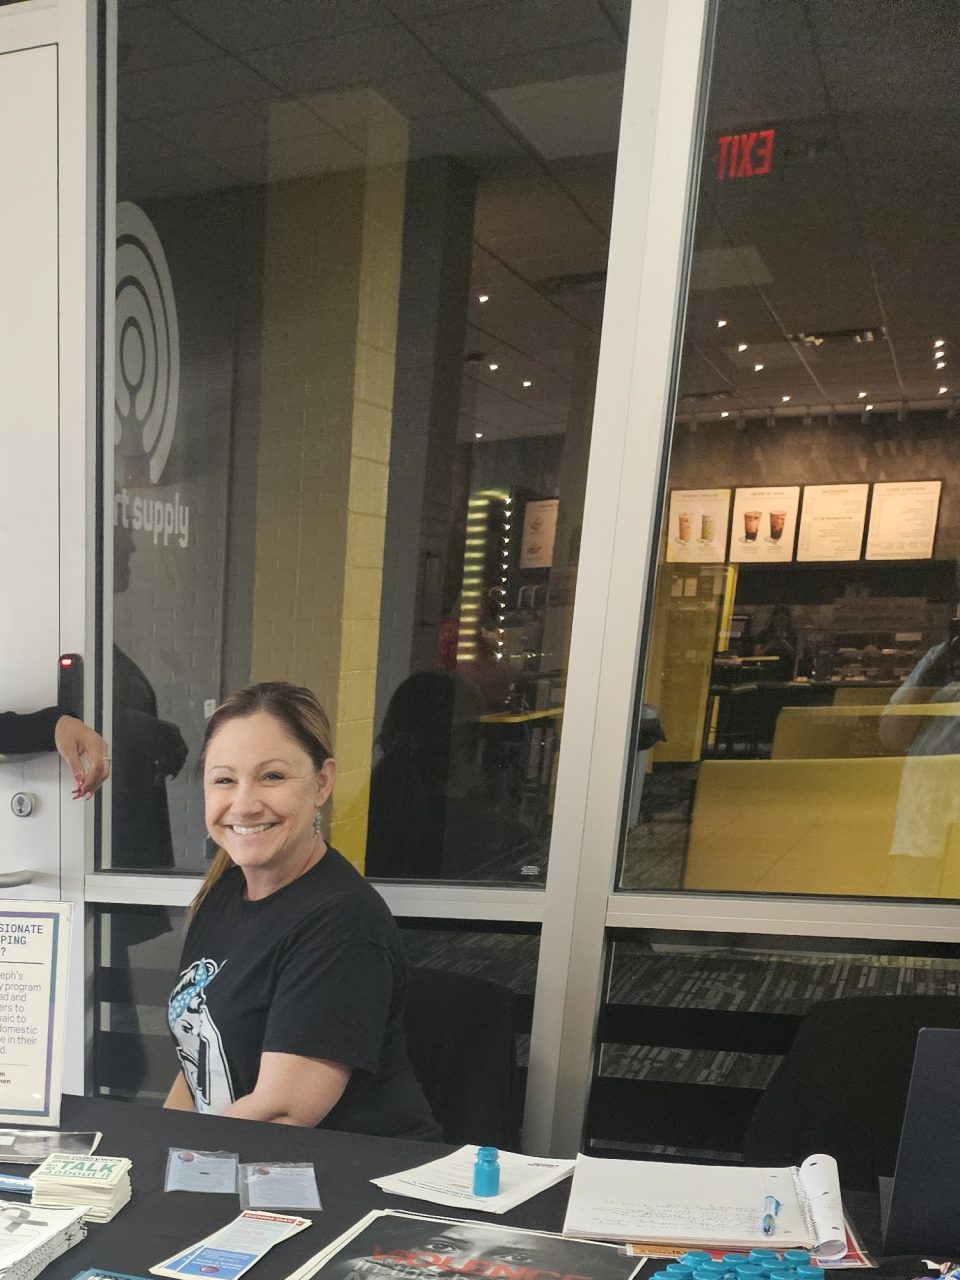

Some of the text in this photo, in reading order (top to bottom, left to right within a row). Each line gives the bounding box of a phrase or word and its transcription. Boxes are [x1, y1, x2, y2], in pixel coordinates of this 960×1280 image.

[133, 492, 189, 548] supply
[5, 982, 42, 992] program
[10, 993, 27, 1002] and
[15, 1004, 25, 1012] to
[16, 1015, 26, 1024] to
[8, 1034, 16, 1044] in
[16, 1035, 38, 1046] their
[60, 1160, 118, 1173] TALK
[53, 1170, 97, 1178] about
